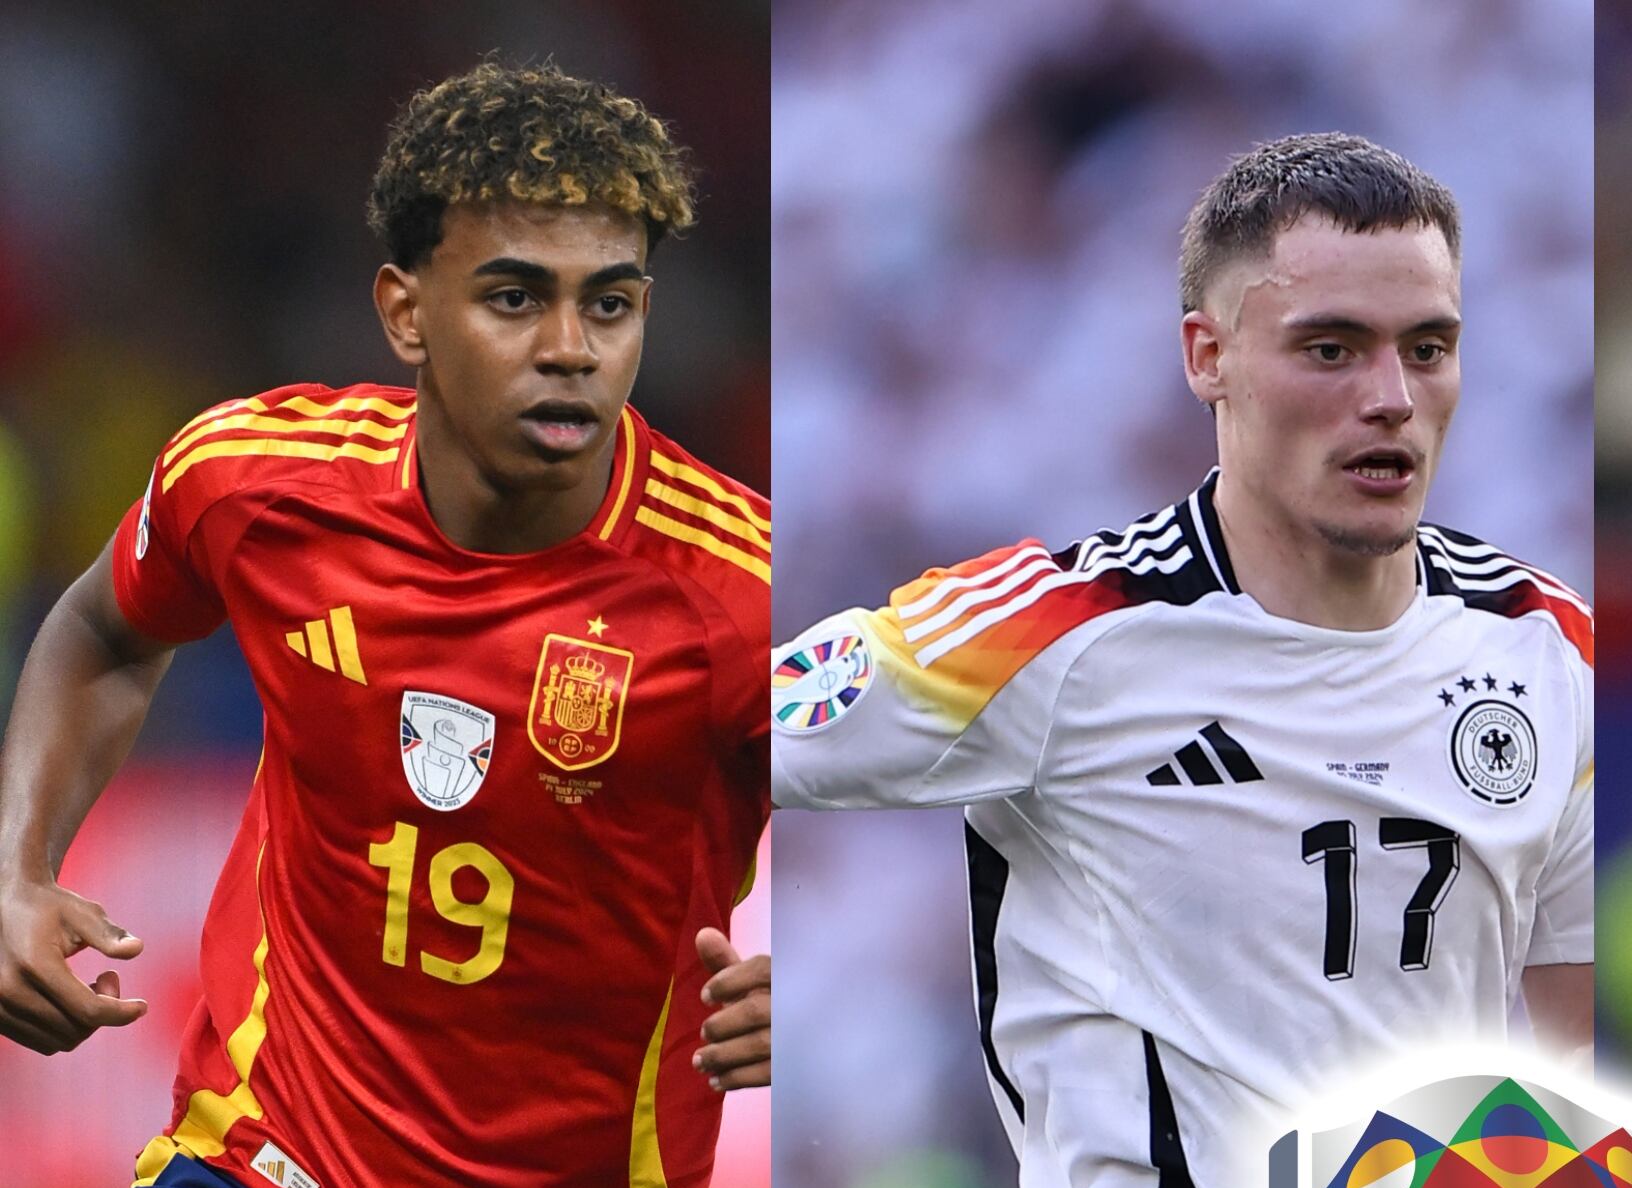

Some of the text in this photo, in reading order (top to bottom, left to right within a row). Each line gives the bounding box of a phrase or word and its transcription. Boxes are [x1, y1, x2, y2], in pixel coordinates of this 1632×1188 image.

[408, 696, 491, 724] UEFA NATIONS LEAGUE
[1468, 712, 1518, 734] DEUTSCHER
[368, 821, 515, 985] 19
[1302, 817, 1460, 981] 17
